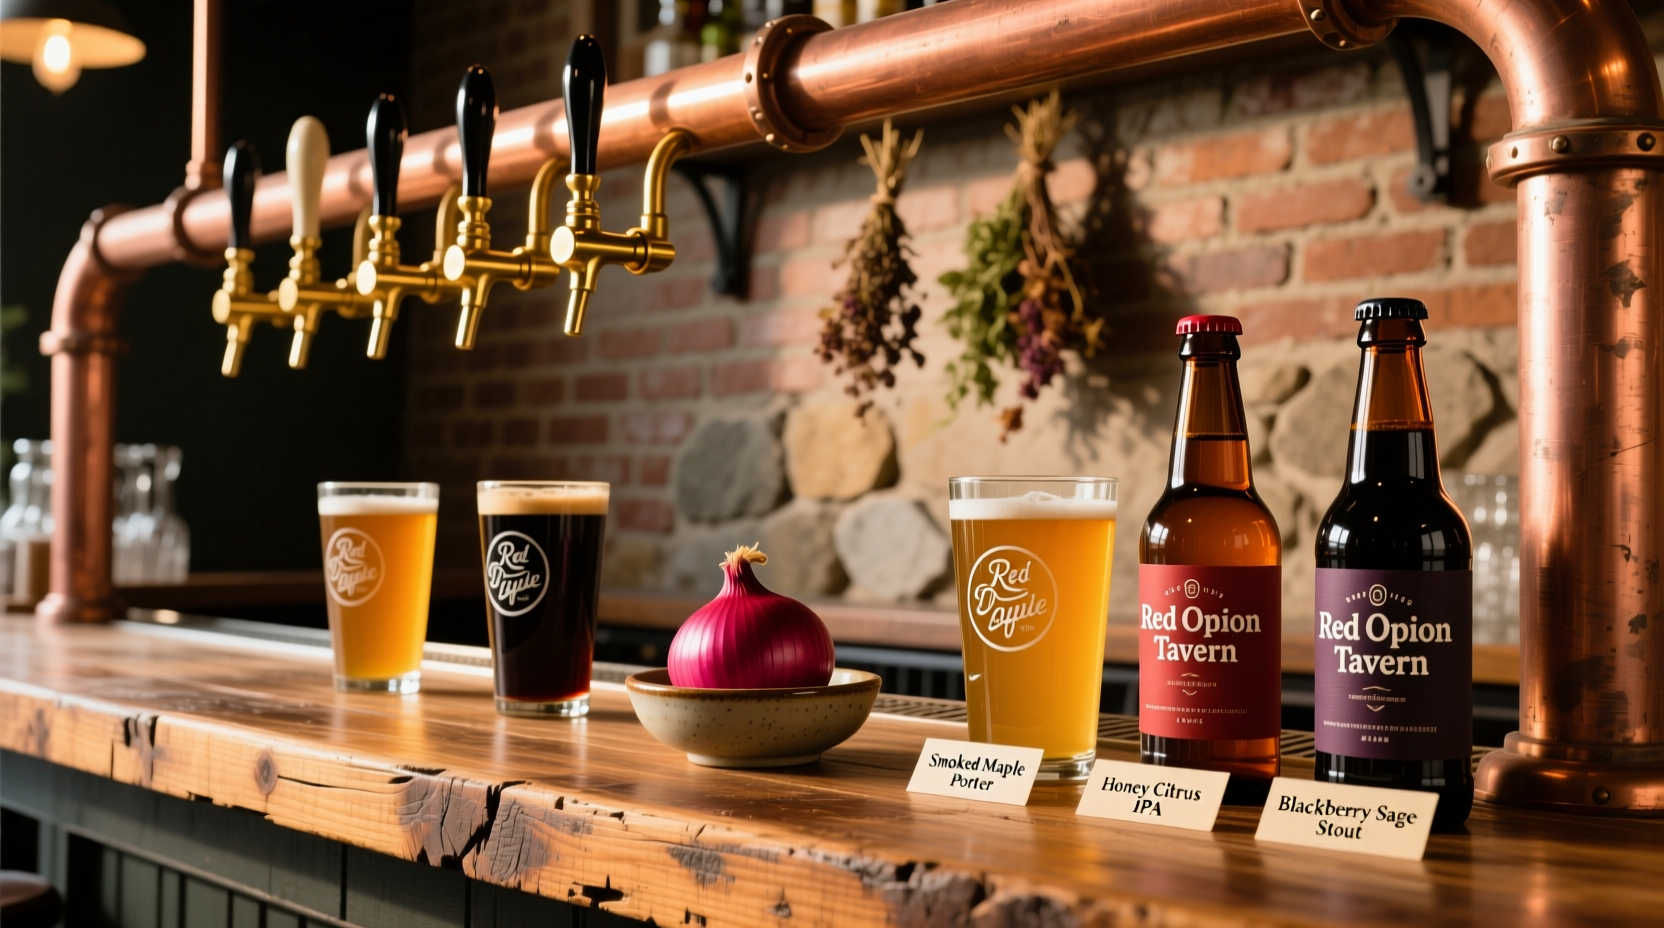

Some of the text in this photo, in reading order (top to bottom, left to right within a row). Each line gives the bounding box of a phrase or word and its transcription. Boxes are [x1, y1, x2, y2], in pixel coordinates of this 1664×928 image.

[988, 558, 1032, 592] Red
[1140, 603, 1262, 638] Red Opion
[1318, 611, 1453, 649] Red Opion
[1153, 635, 1239, 662] Tavern
[1333, 645, 1430, 676] Tavern
[928, 753, 1026, 778] Smoked Maple
[949, 773, 995, 791] Porter
[1101, 776, 1202, 801] Honey Citrus
[1132, 799, 1162, 817] IPA
[1277, 795, 1418, 829] Blackberry Sage
[1315, 819, 1363, 840] Stout
